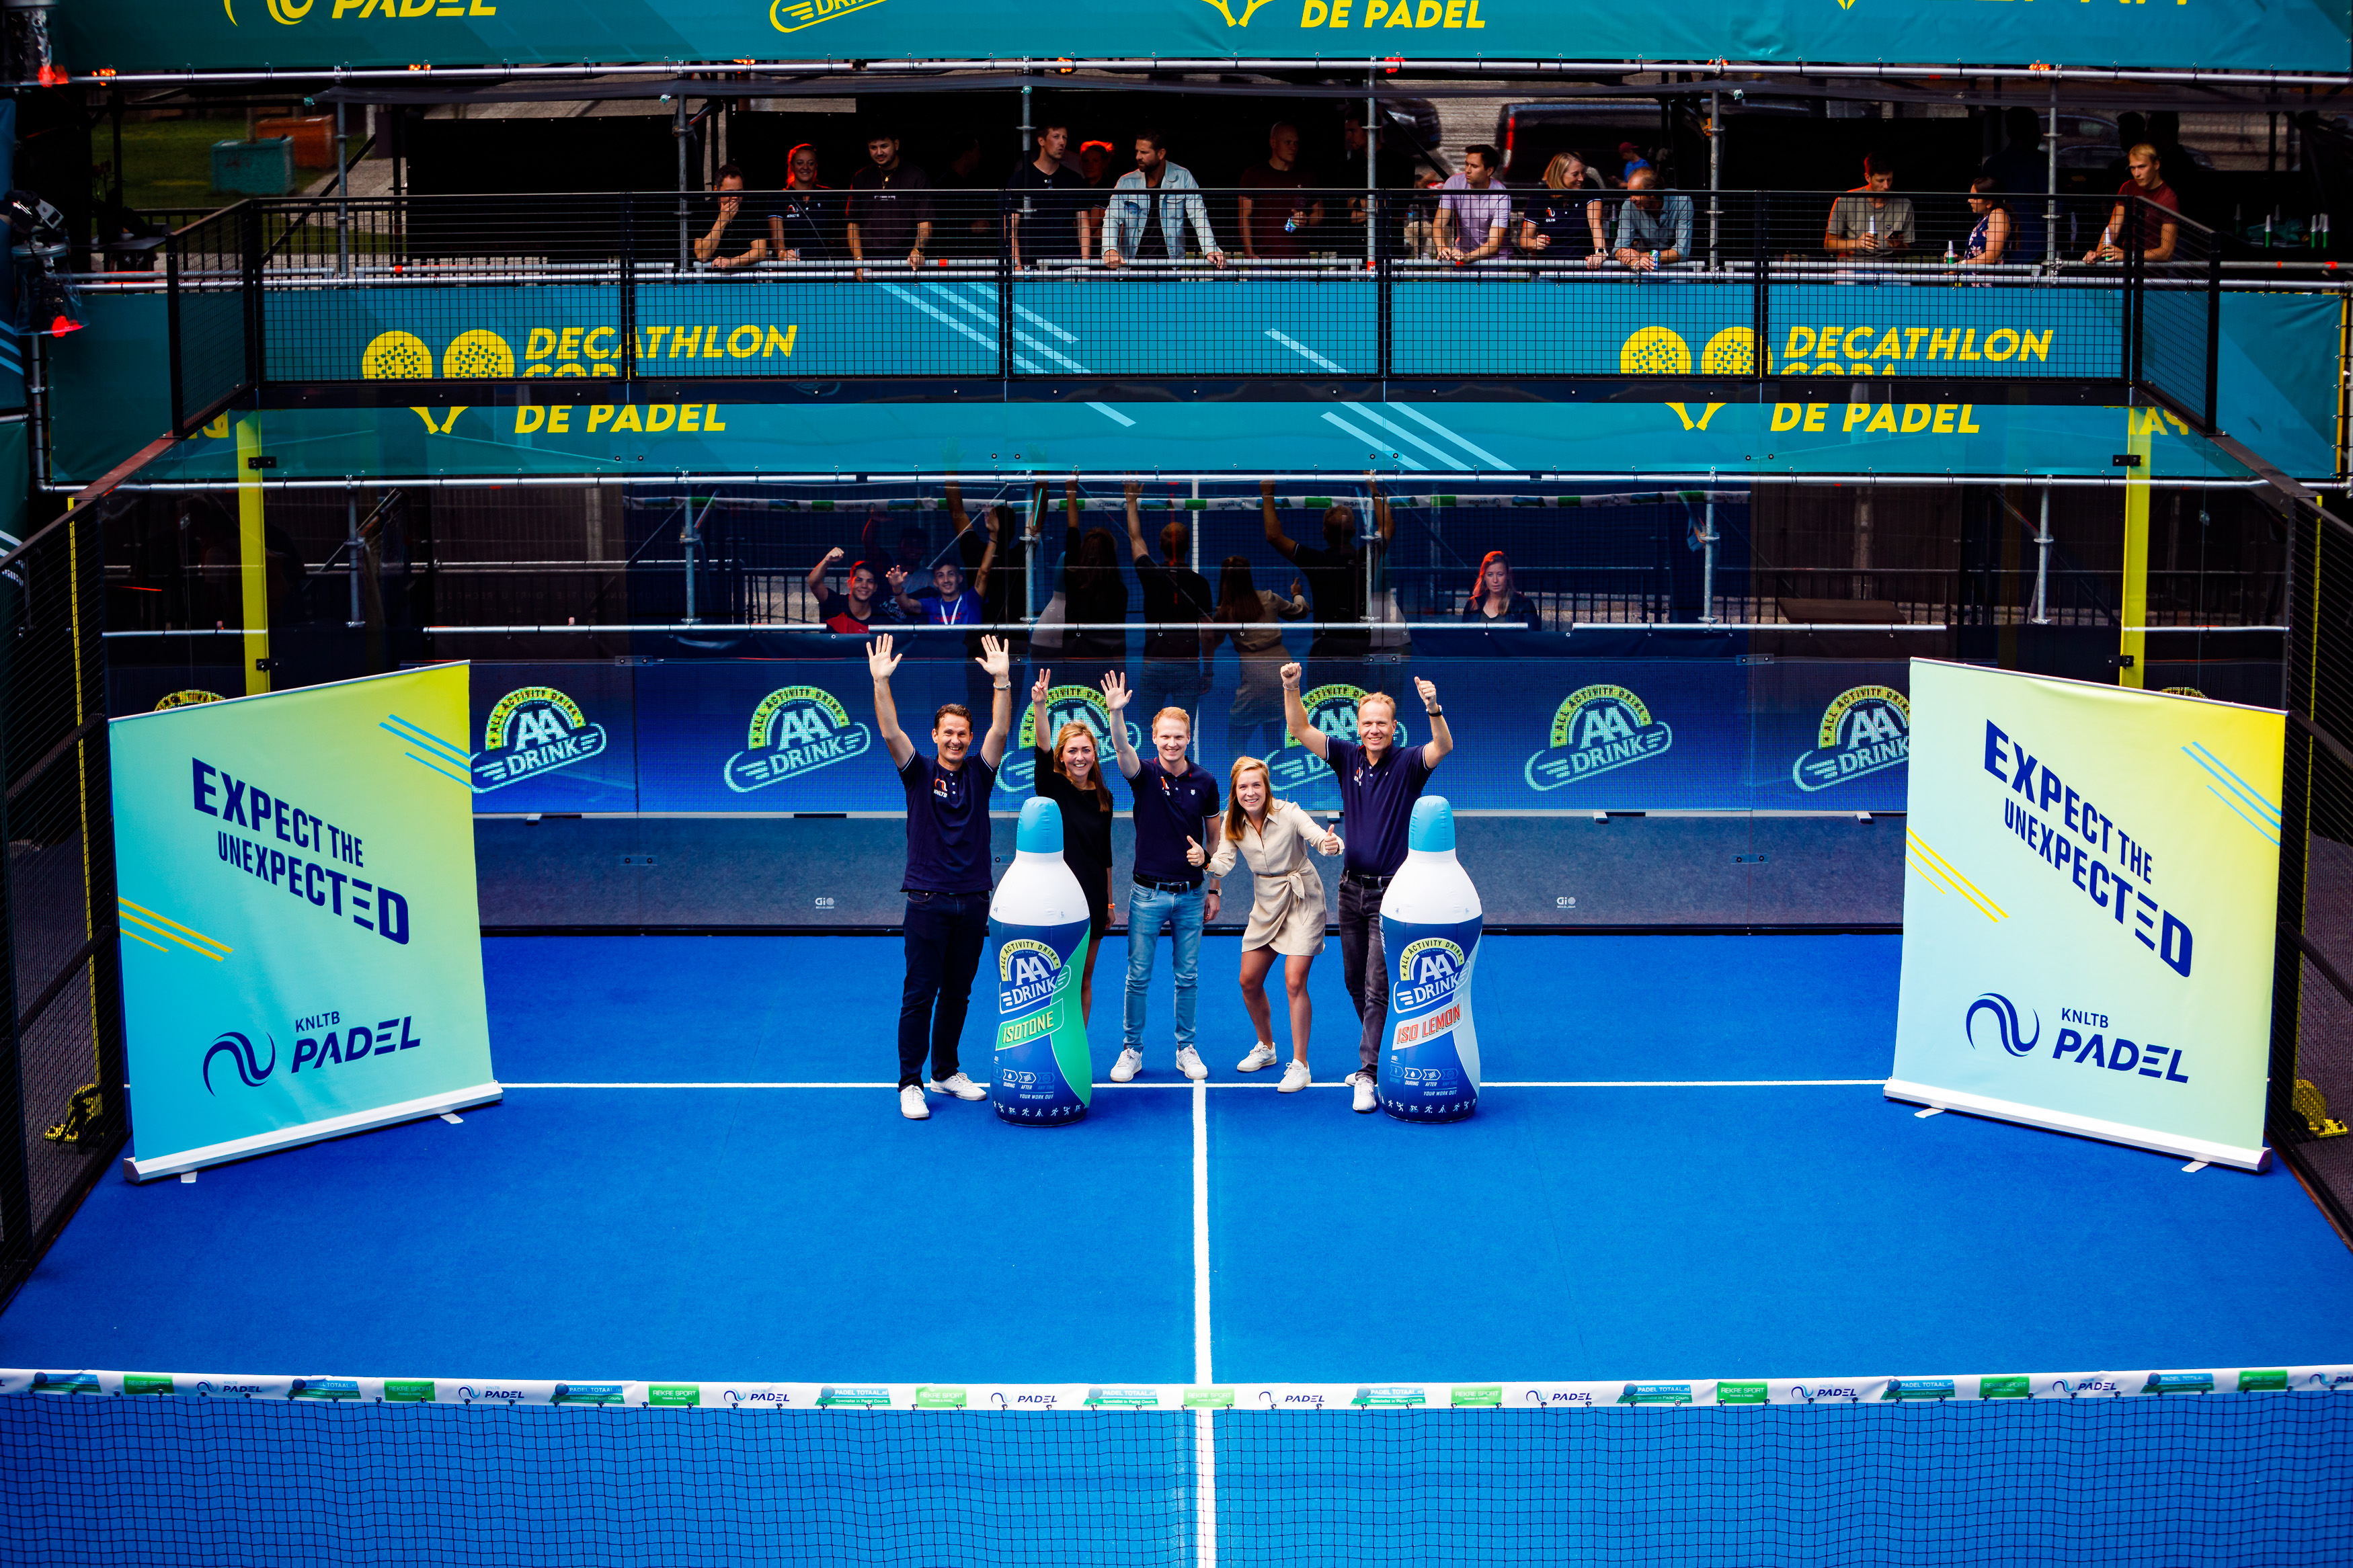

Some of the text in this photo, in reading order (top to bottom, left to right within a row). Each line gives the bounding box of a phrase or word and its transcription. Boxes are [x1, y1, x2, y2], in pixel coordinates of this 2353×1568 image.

[1300, 0, 1486, 28] DE PADEL
[1783, 326, 2055, 362] DECATHLON
[514, 403, 725, 434] DE PADEL
[1770, 403, 1980, 434] DE PADEL
[514, 708, 571, 752] AA
[777, 707, 834, 751] AA
[1579, 705, 1635, 750] AA
[1847, 706, 1903, 751] AA
[506, 737, 582, 776] DRINK
[769, 736, 846, 774] DRINK
[1570, 735, 1647, 774] DRINK
[933, 788, 948, 798] KNLTB
[1985, 718, 2152, 885] EXPECT THE
[192, 757, 364, 868] EXPECT THE
[218, 830, 409, 945] UNEXPECTED
[2005, 797, 2193, 978] UNEXPECTED
[1004, 941, 1035, 955] ACTIVITY
[1037, 944, 1058, 962] DRINK
[1401, 940, 1463, 971] ALL ACTIVITY DRINK
[1016, 956, 1050, 987] AA
[1419, 954, 1455, 985] AA
[1011, 975, 1058, 1005] DRINK
[1412, 972, 1460, 1003] DRINK
[295, 1011, 341, 1033] KNLTB
[1002, 1010, 1054, 1044] ISOTONE
[1397, 1003, 1461, 1044] ISO LEMON
[2061, 1007, 2109, 1028] KNLTB
[291, 1016, 421, 1074] PADEL
[2052, 1028, 2189, 1083] PADEL
[484, 1391, 525, 1399] PADEL
[750, 1393, 790, 1402] PADEL
[1017, 1395, 1058, 1403] PADEL
[1552, 1393, 1592, 1401] PADEL
[1817, 1388, 1857, 1397] PADEL
[2077, 1382, 2117, 1391] PADEL
